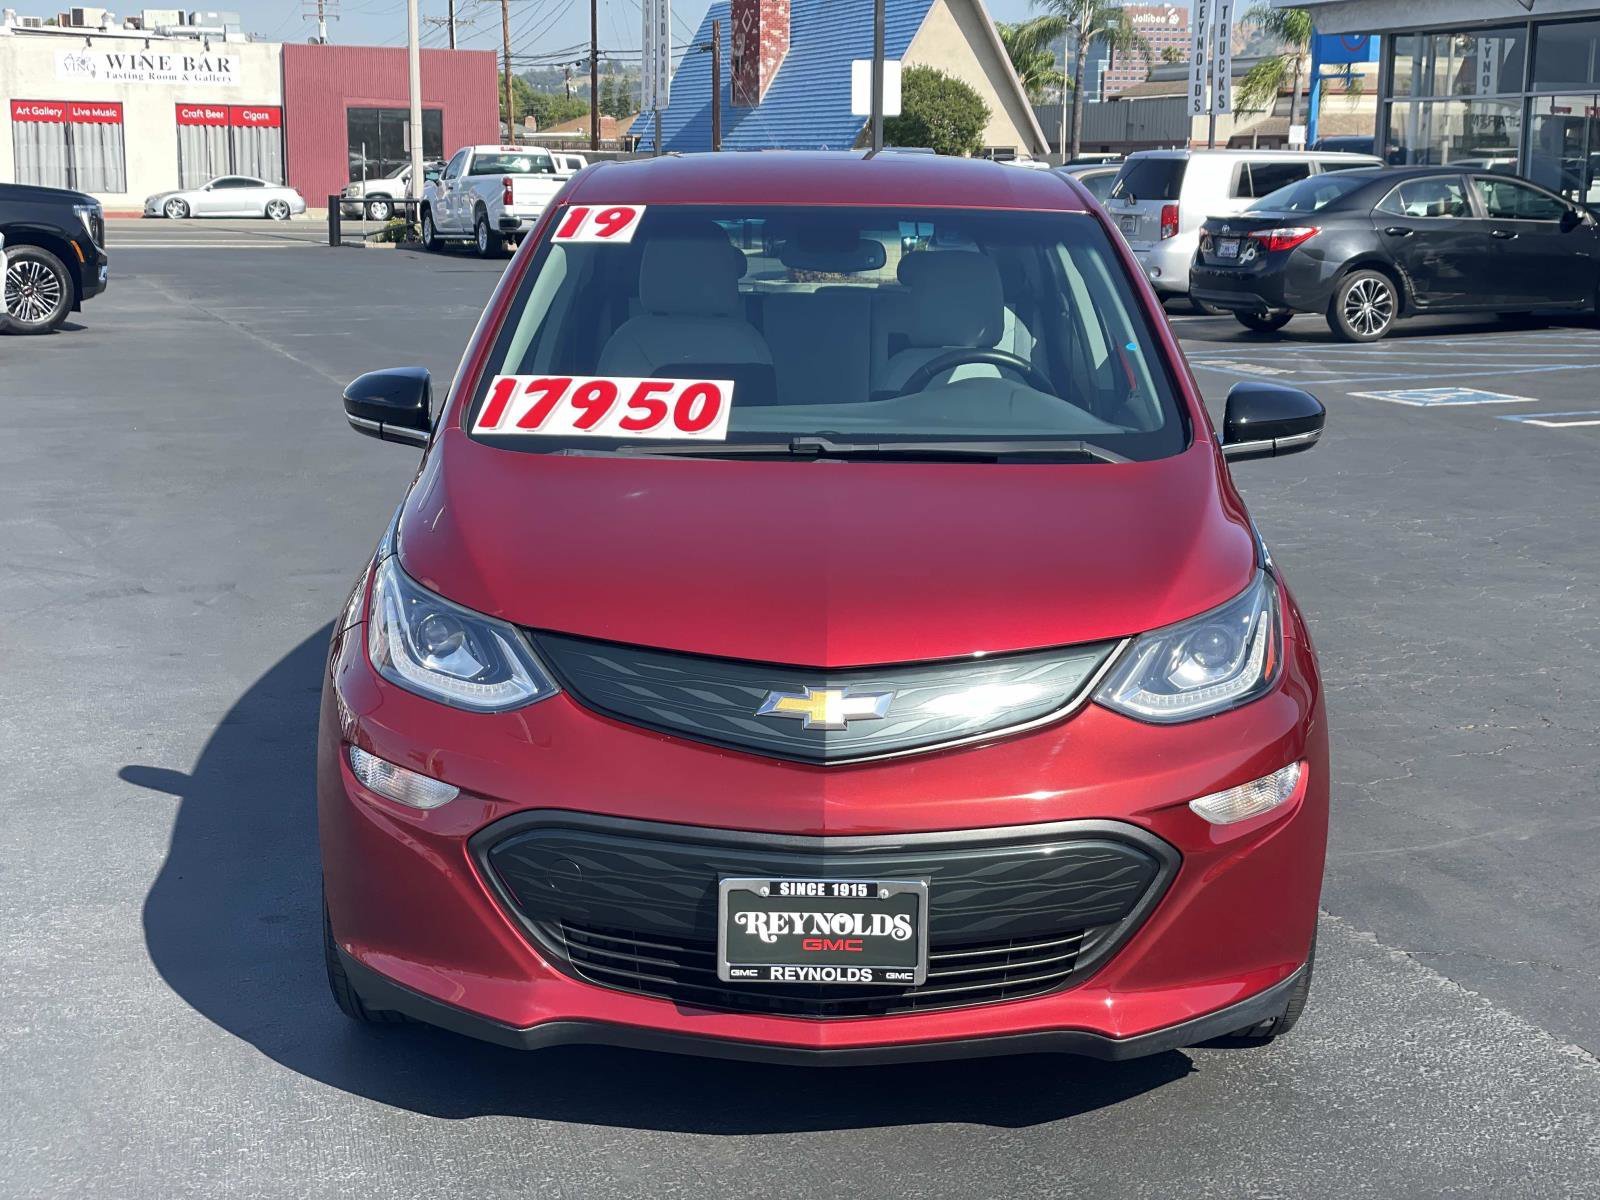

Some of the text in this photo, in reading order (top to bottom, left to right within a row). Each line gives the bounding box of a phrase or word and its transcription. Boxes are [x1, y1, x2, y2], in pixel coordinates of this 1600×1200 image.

[1132, 12, 1166, 24] Jollibee
[106, 54, 171, 70] WINE
[183, 56, 231, 72] BAR
[1194, 0, 1206, 112] EYNOLDS
[1218, 5, 1229, 109] TRUCKS
[106, 71, 144, 81] Tasting
[149, 72, 177, 81] Room
[194, 74, 231, 82] Gallery
[16, 106, 62, 117] Art Gallery
[72, 107, 117, 117] Live Music
[182, 109, 224, 119] Craft Beer
[243, 110, 269, 121] Cigars
[556, 207, 637, 239] 19
[478, 378, 722, 433] 17950
[780, 882, 868, 897] SINCE 1915
[734, 911, 913, 943] REYNOLDS
[802, 938, 863, 952] GMC
[730, 966, 913, 982] GMC REYNOLDS GMC
